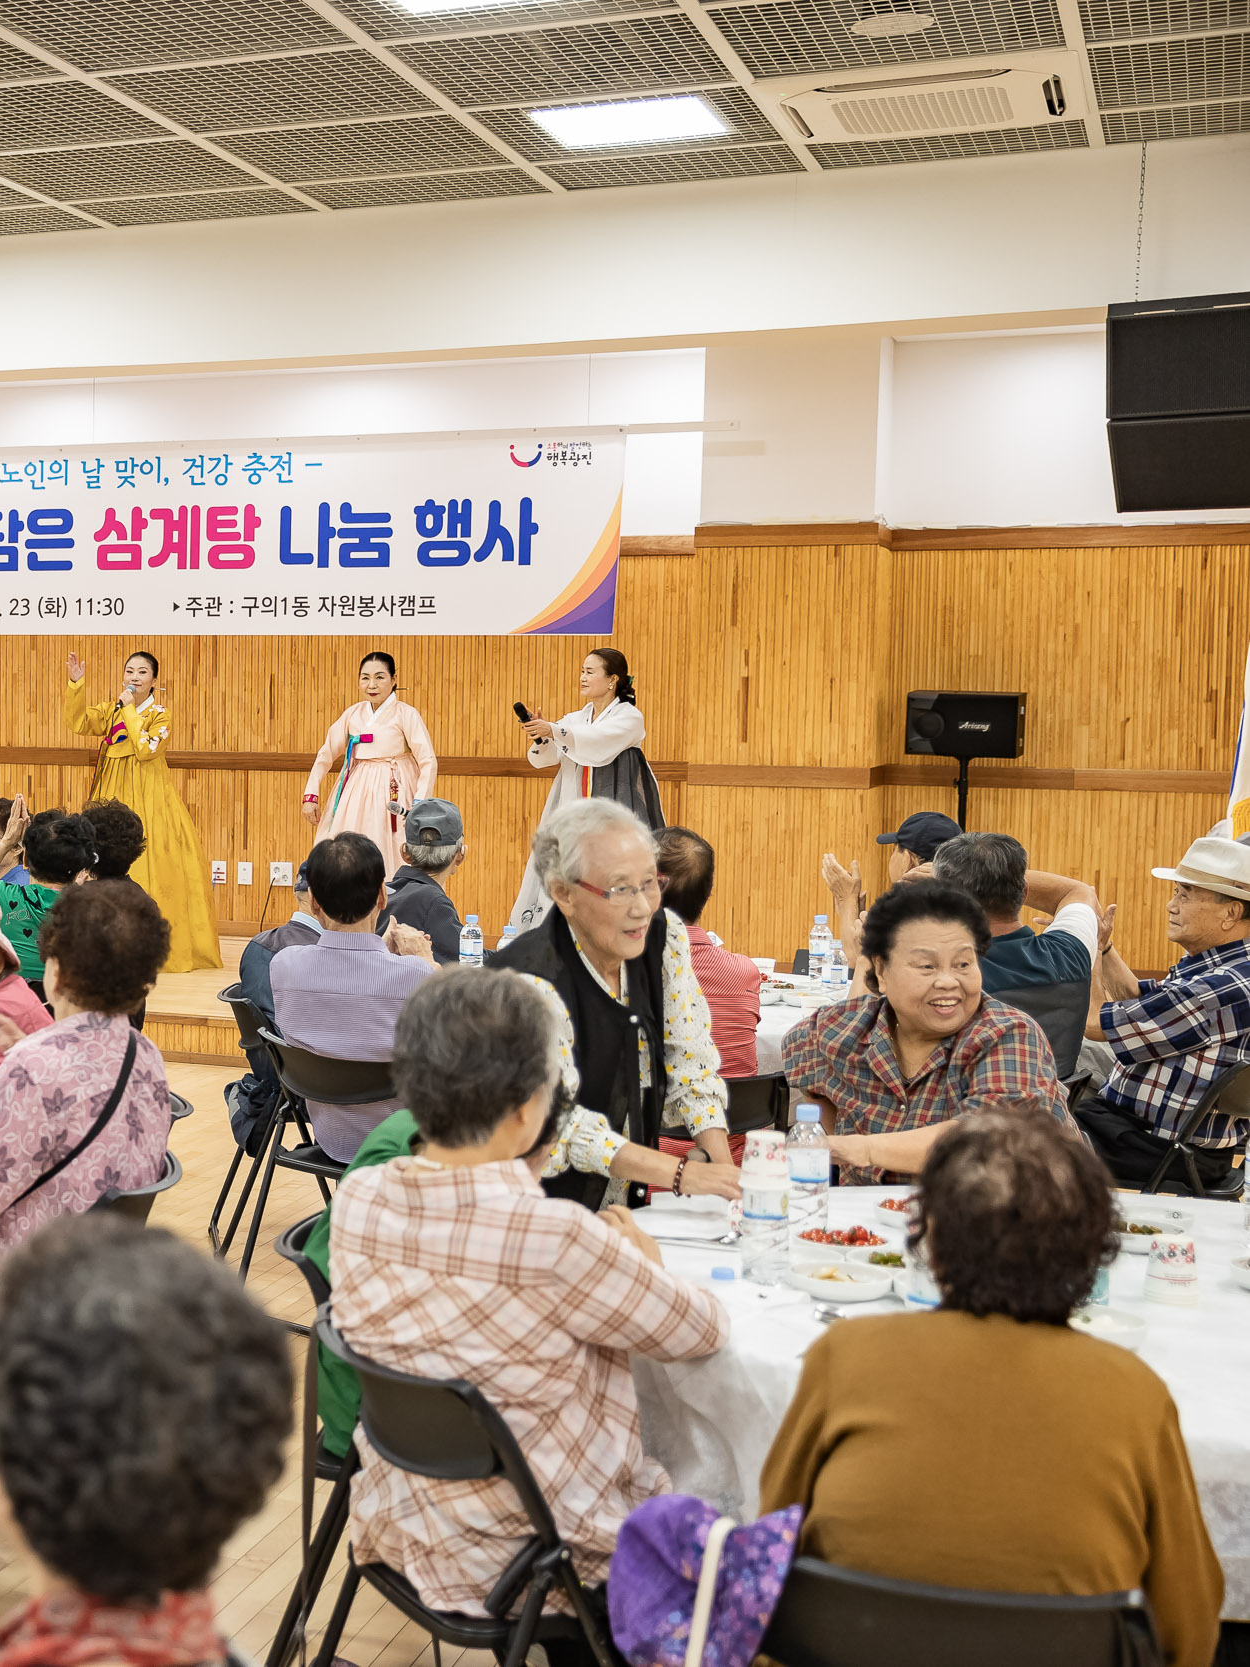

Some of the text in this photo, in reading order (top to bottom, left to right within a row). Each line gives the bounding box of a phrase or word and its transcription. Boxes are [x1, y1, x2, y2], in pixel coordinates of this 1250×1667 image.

[81, 458, 105, 489] 날
[114, 456, 170, 489] 맞이,
[182, 453, 234, 486] 건강
[241, 451, 294, 485] 충전
[546, 450, 592, 467] 행복광진
[93, 503, 262, 570] 삼계탕
[279, 501, 393, 568] 나눔
[414, 496, 539, 567] 행사
[9, 598, 30, 616] 23
[37, 596, 68, 619] (화)
[75, 597, 125, 616] 11:30
[185, 596, 223, 617] 주관
[241, 596, 310, 617] 구의1동
[317, 595, 437, 617] 자원봉사캠프
